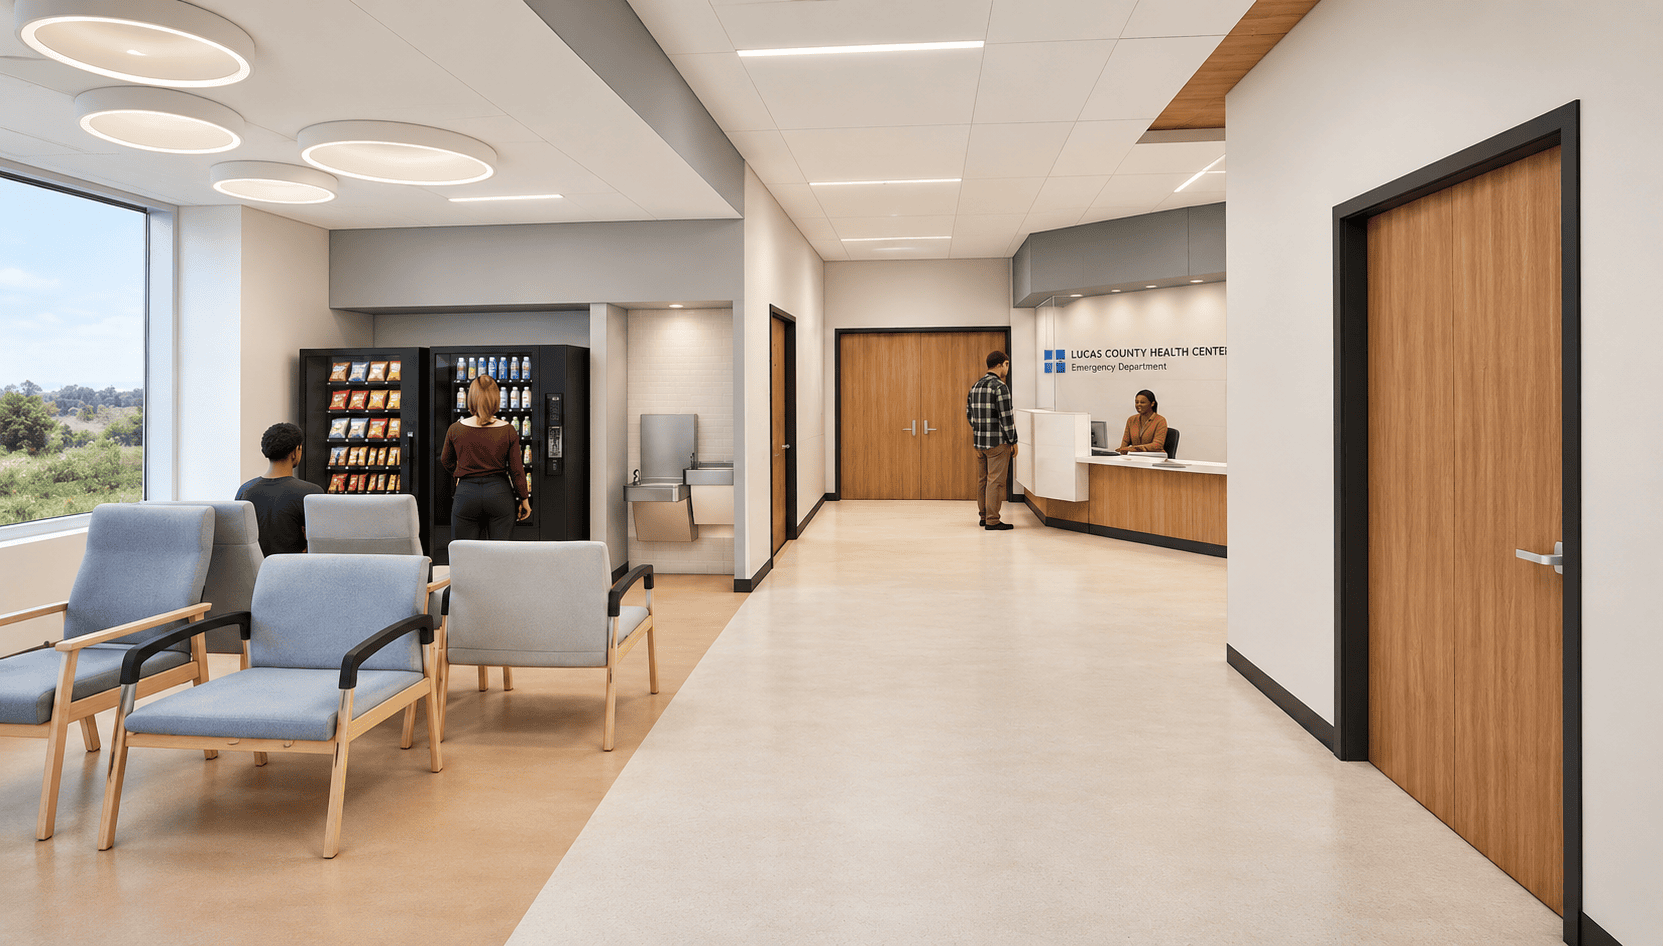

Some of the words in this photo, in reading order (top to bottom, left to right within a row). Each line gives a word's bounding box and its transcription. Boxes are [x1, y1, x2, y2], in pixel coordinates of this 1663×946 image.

[1071, 349, 1103, 359] LUCAS
[1104, 348, 1148, 358] COUNTY
[1149, 347, 1189, 357] HEALTH
[1071, 363, 1116, 374] Emergency
[1118, 362, 1167, 373] Department
